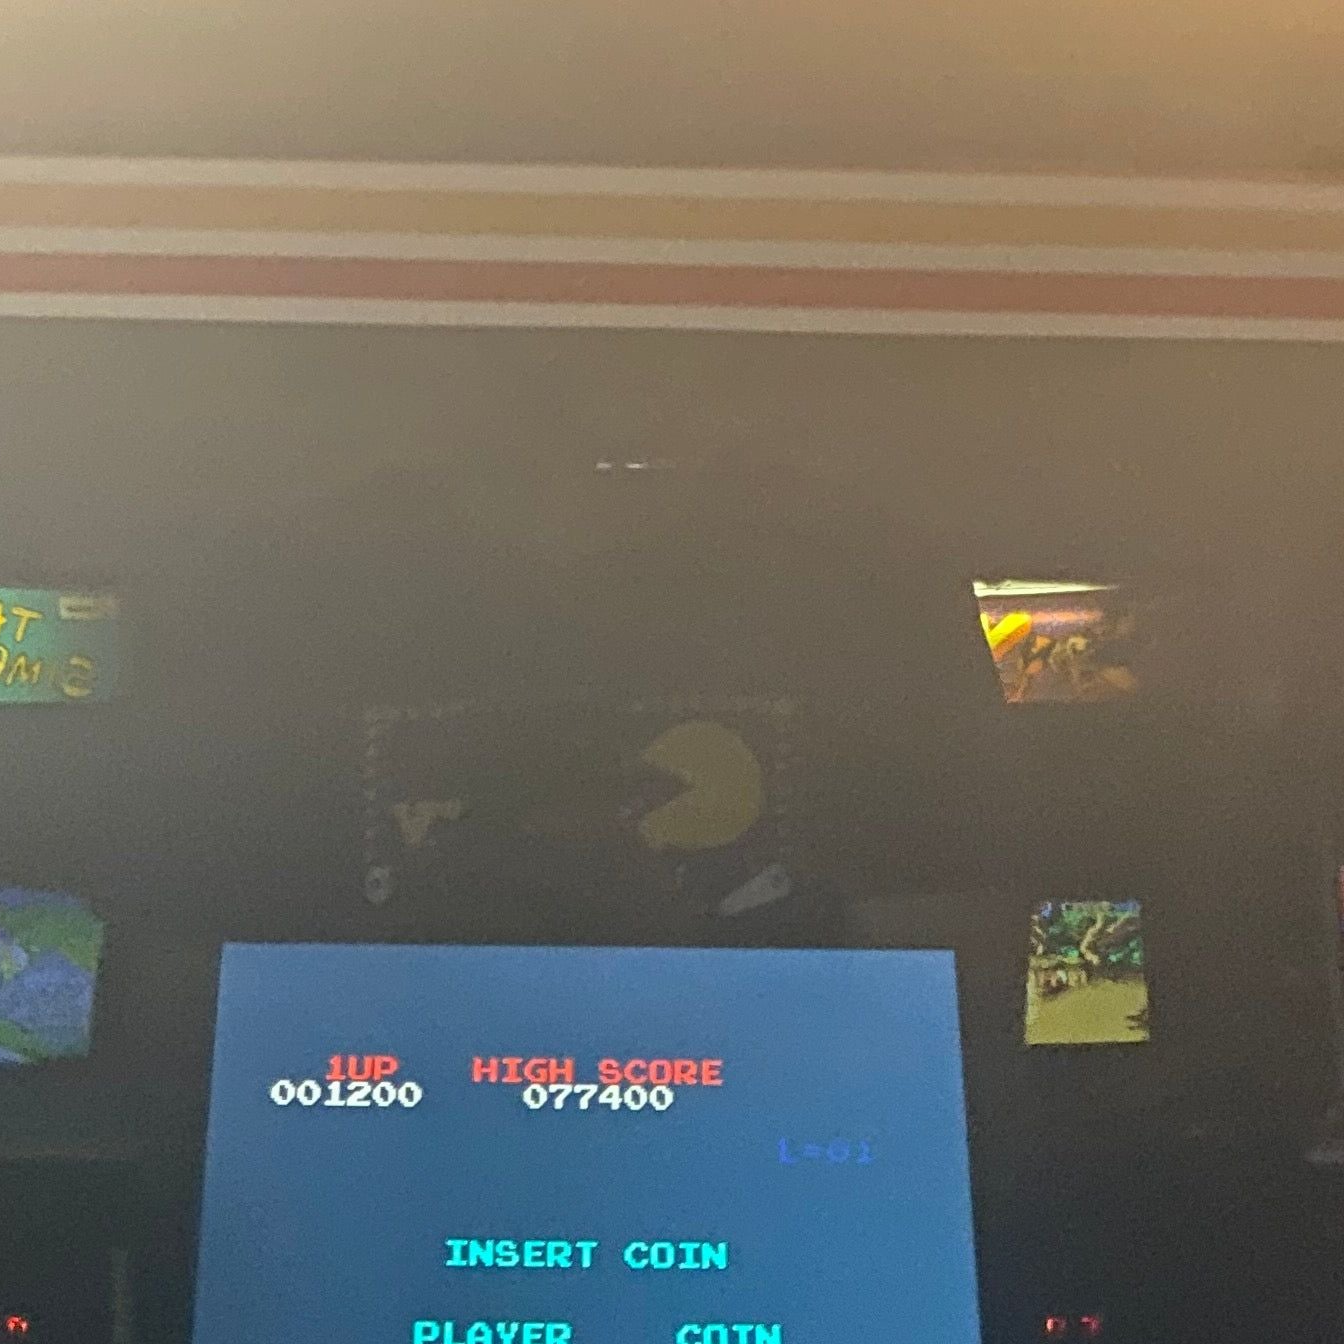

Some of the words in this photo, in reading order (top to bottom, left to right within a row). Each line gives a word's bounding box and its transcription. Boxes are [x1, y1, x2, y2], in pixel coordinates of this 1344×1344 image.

[326, 1054, 399, 1083] 1UP
[471, 1056, 575, 1086] HIGH
[598, 1058, 723, 1086] SCORE
[270, 1080, 423, 1108] 001200
[522, 1083, 674, 1112] 077400
[445, 1239, 598, 1269] INSERT
[623, 1240, 728, 1271] COIN
